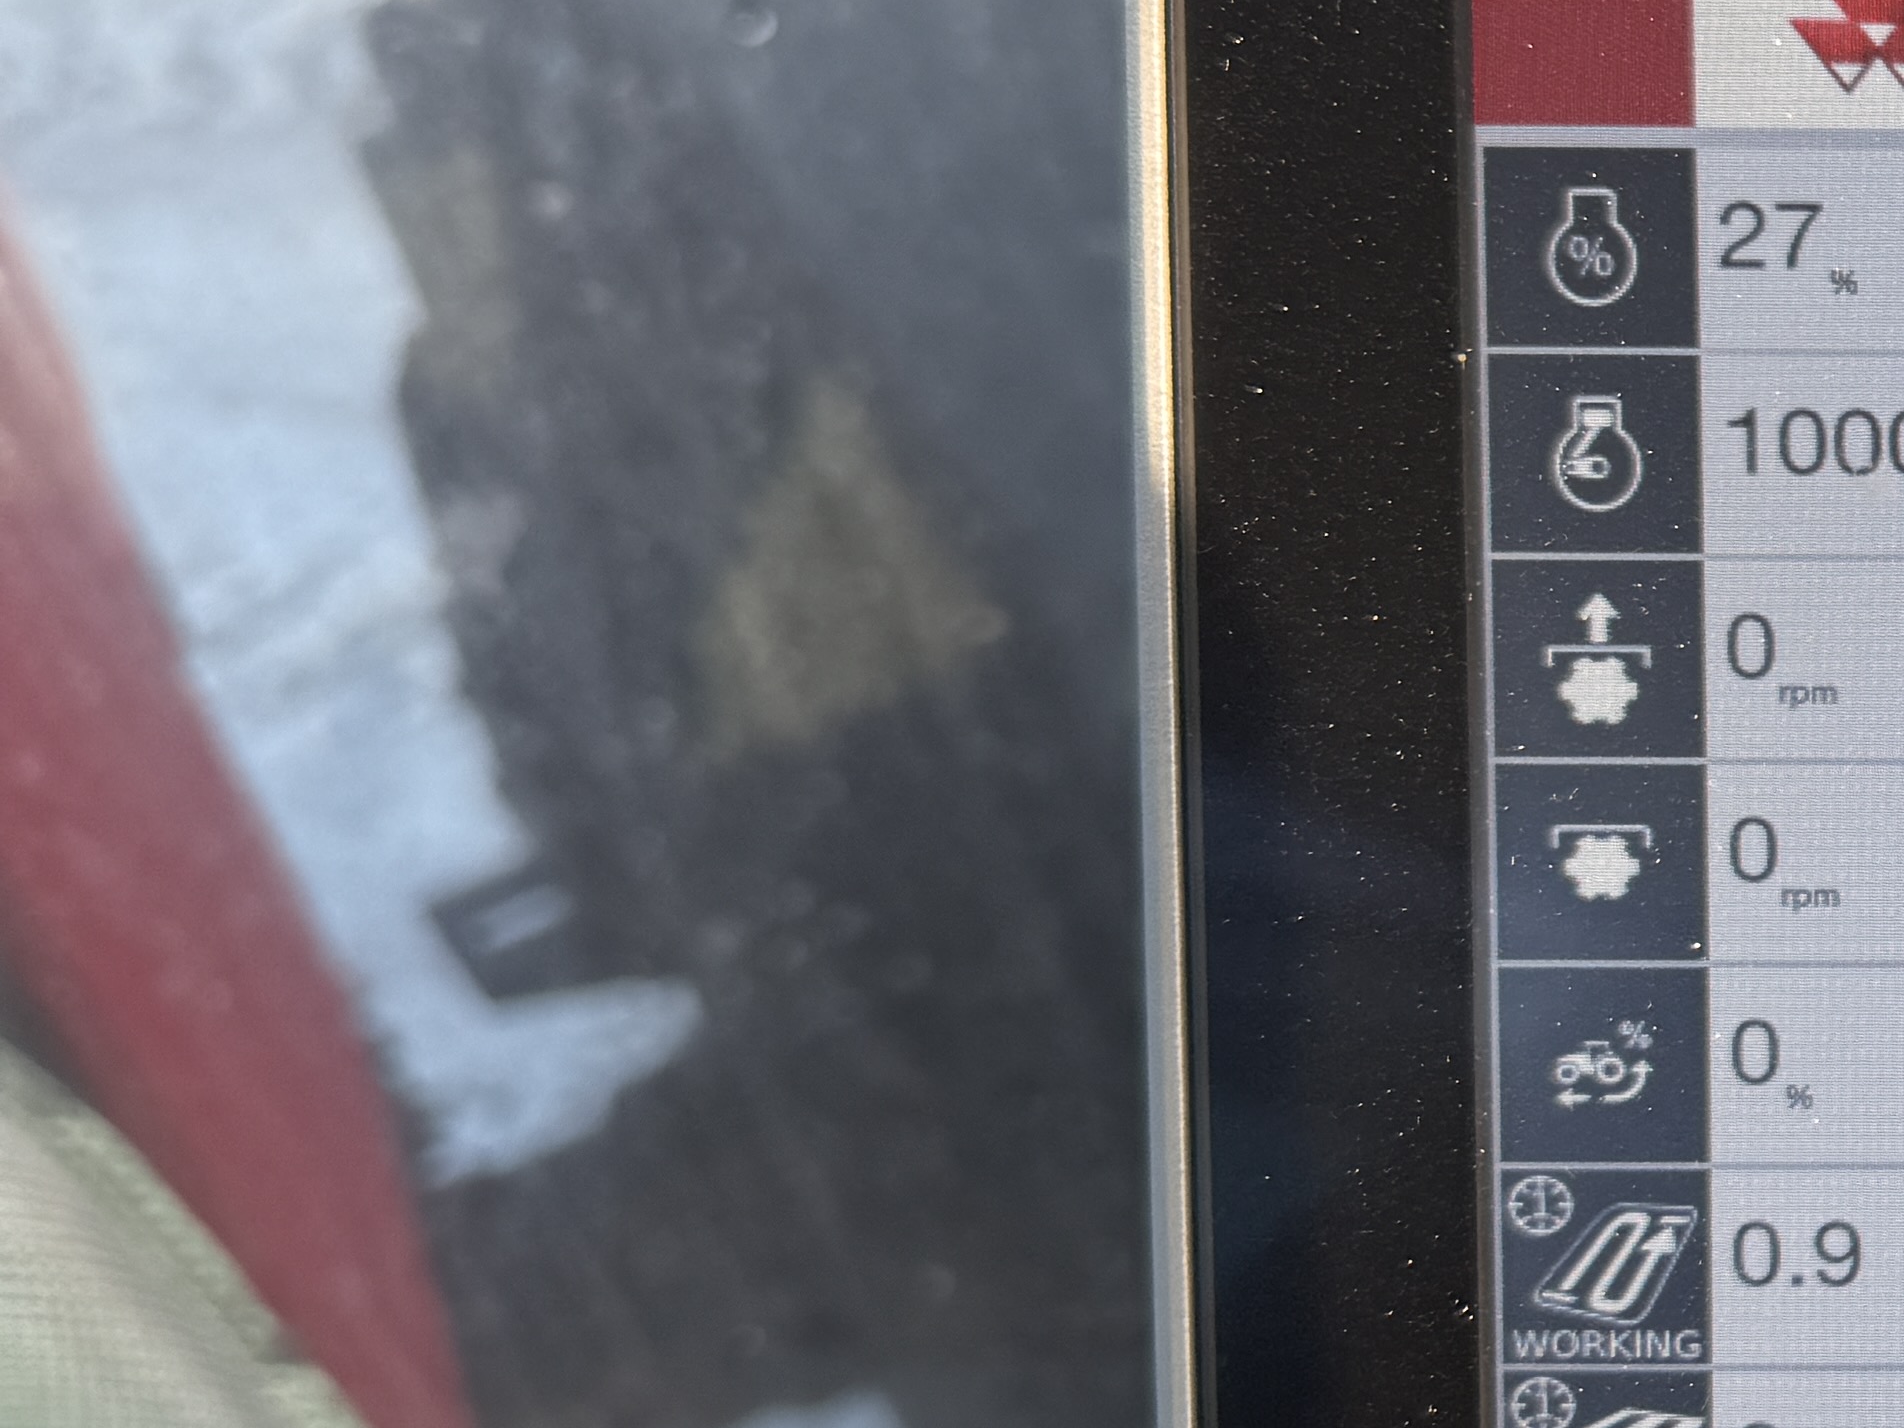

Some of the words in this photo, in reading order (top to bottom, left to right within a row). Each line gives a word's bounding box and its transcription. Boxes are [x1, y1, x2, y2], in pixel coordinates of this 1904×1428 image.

[1719, 203, 1823, 269] 27
[1831, 270, 1858, 295] %
[1727, 613, 1775, 680] 0
[1778, 682, 1838, 708] rpm
[1729, 818, 1778, 883] 0
[1780, 886, 1841, 912] rpm
[1731, 1019, 1779, 1085] 0
[1785, 1085, 1814, 1109] %
[1732, 1221, 1862, 1287] 0.9
[1513, 1329, 1702, 1360] WORKING
